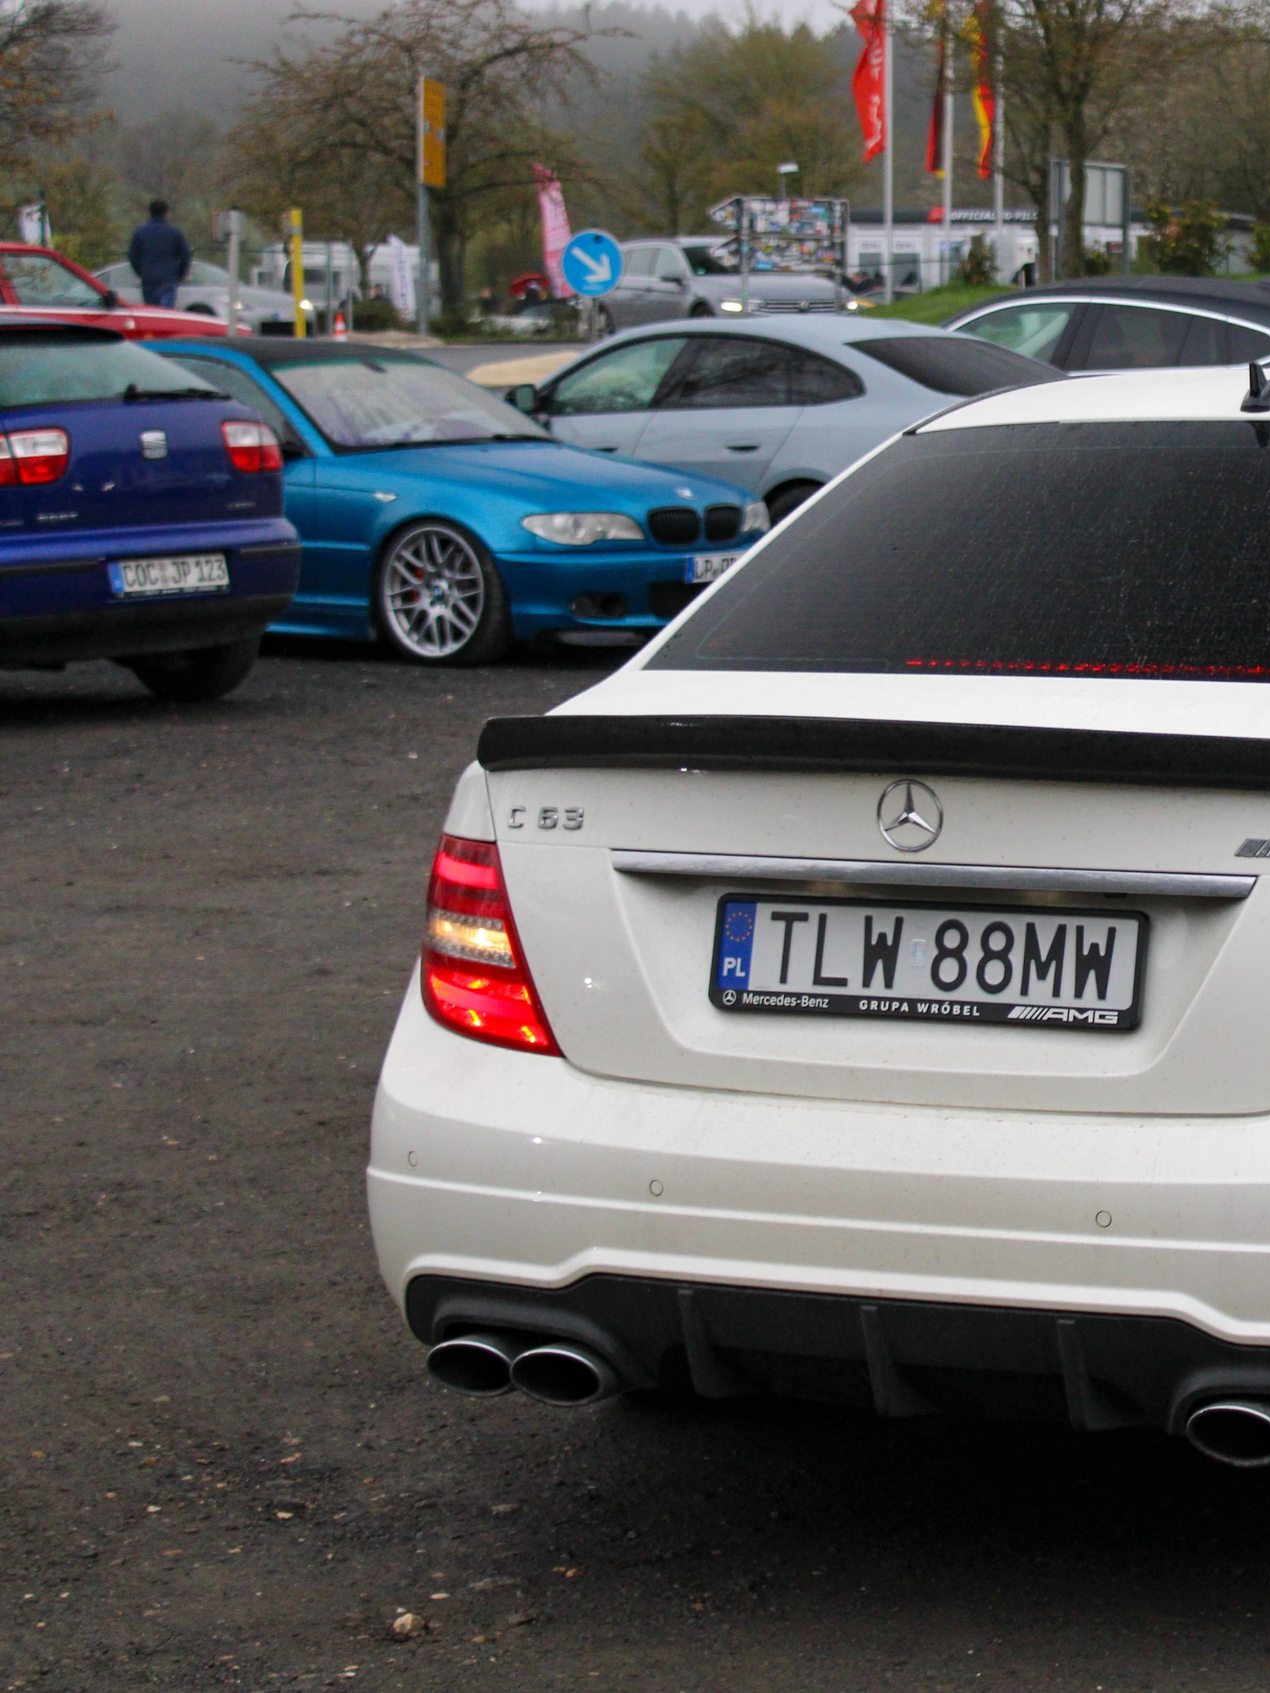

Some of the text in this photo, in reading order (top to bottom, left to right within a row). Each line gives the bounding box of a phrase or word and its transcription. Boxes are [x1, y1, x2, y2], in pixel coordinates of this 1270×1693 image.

[951, 211, 997, 221] OFFICIAL
[123, 557, 228, 588] COC JP 123
[694, 559, 714, 579] LP
[508, 805, 585, 832] C 63
[770, 910, 1118, 1001] TLW 88MW
[722, 957, 746, 979] PL
[742, 992, 829, 1009] Mercedes-Benz
[859, 999, 981, 1017] GRUPA WRÓBEL
[1044, 1008, 1119, 1025] AMG
